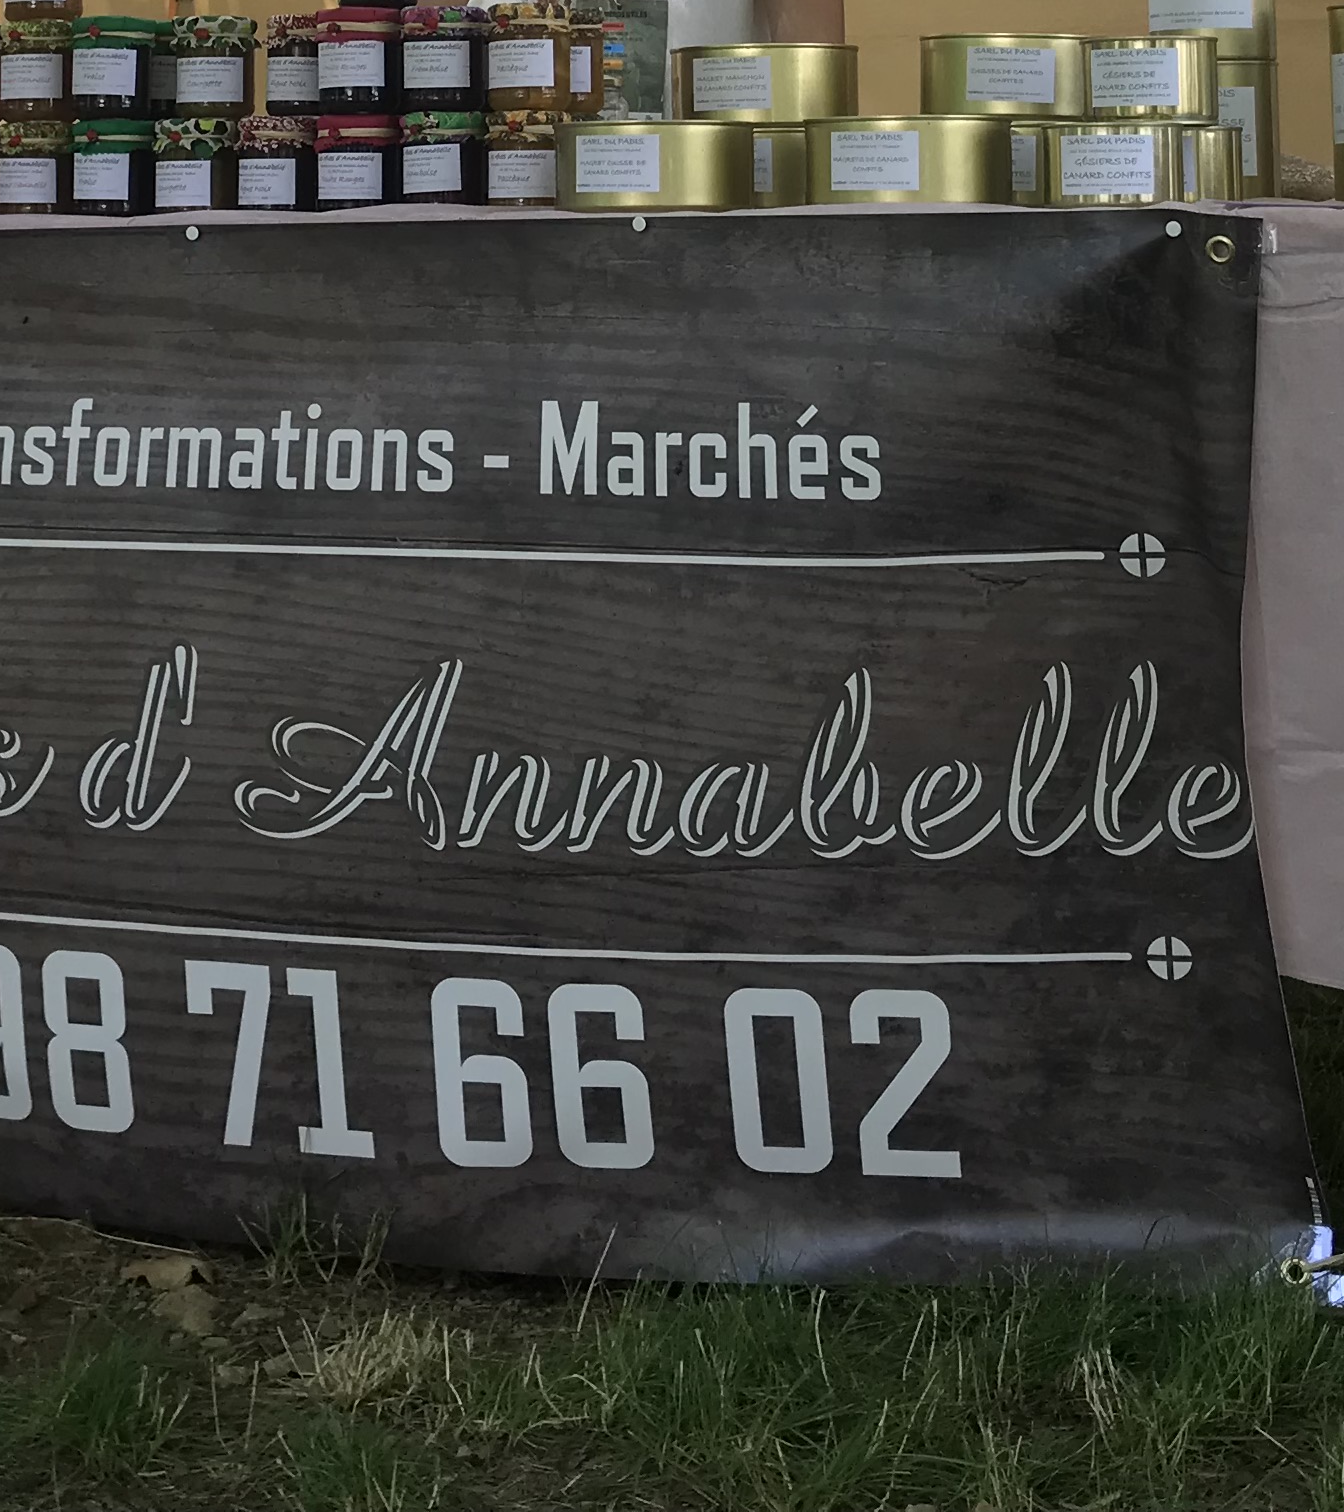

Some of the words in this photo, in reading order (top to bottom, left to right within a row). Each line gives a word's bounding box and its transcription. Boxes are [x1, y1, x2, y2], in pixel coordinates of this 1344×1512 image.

[1067, 137, 1094, 145] SARL
[1115, 136, 1146, 144] PADIS
[1124, 157, 1137, 165] DE
[1063, 171, 1104, 179] CANARD
[1106, 170, 1152, 179] CONFITS
[539, 399, 884, 502] Marchés
[184, 958, 376, 1160] 71
[430, 976, 656, 1170] 66
[724, 986, 963, 1179] 02
